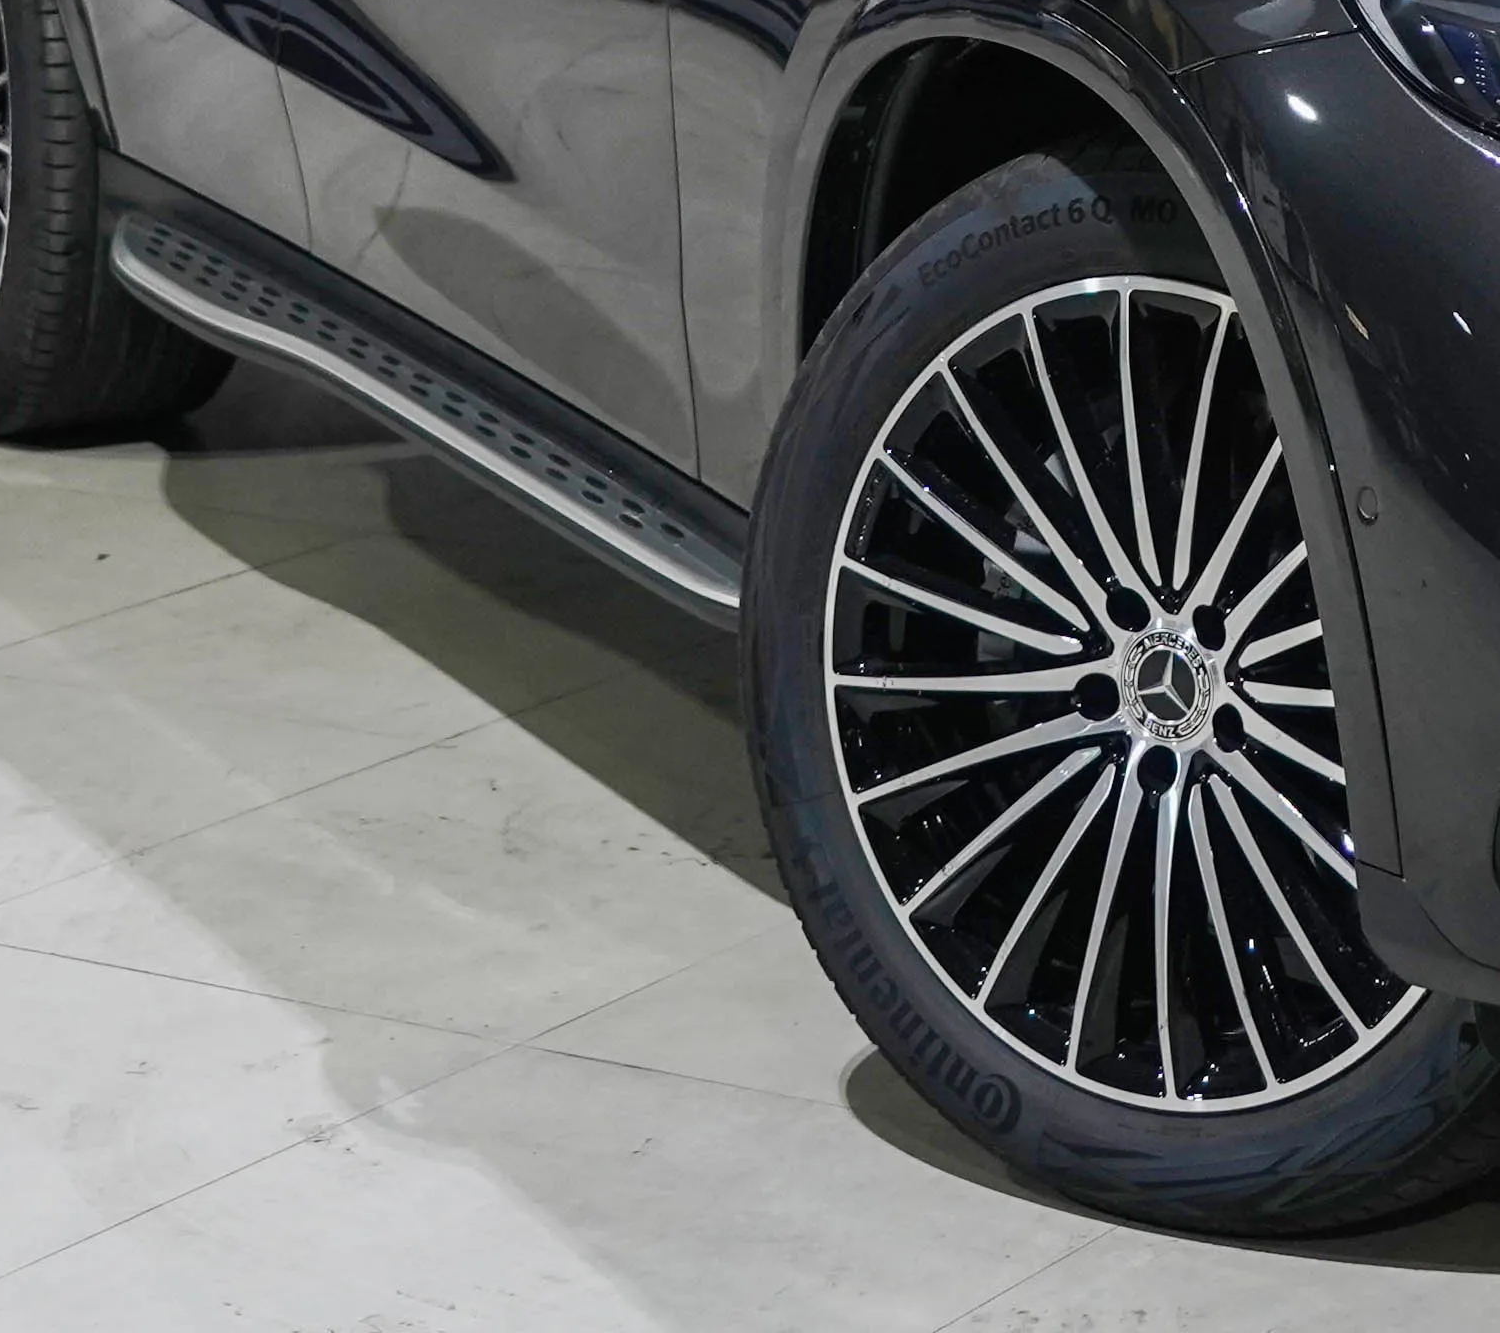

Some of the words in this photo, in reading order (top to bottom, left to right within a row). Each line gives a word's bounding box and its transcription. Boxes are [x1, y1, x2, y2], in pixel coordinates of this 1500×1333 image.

[917, 202, 1063, 289] EcoContact
[1067, 197, 1086, 225] 6
[1090, 194, 1114, 225] Q
[1129, 194, 1178, 225] MO
[807, 879, 1022, 1136] Continental
